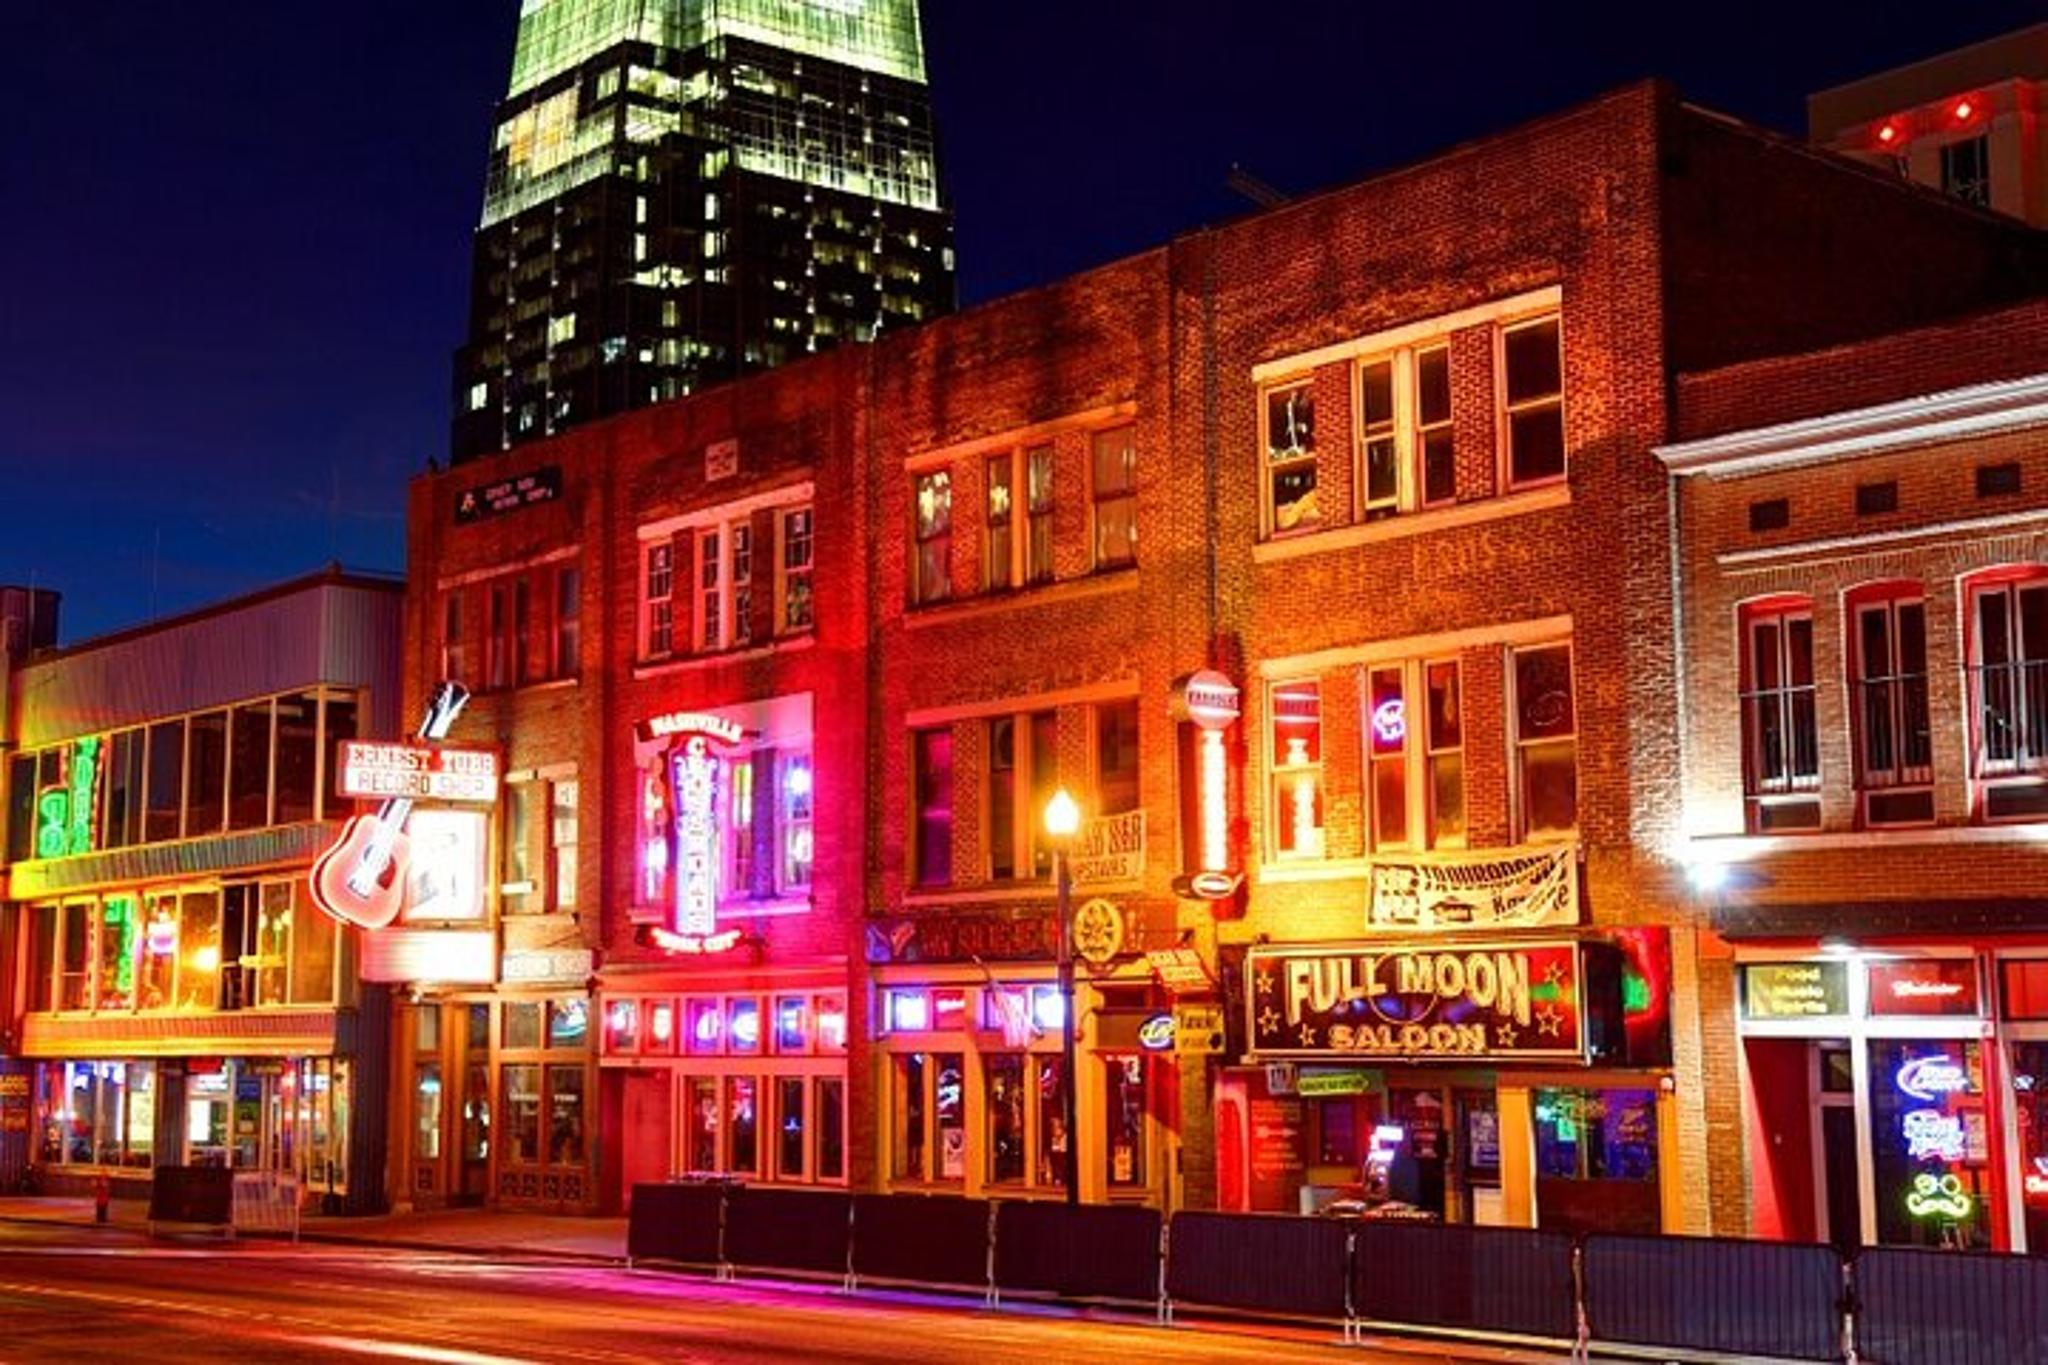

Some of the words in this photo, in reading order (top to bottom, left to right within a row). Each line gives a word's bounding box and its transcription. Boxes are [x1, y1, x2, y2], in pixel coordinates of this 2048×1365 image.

[649, 711, 744, 743] NASHVILLE
[345, 743, 432, 771] ERNEST
[357, 770, 431, 794] RECORD
[1286, 957, 1387, 1028] FULL
[1397, 951, 1533, 1028] MOON
[1328, 1023, 1490, 1055] SALOON
